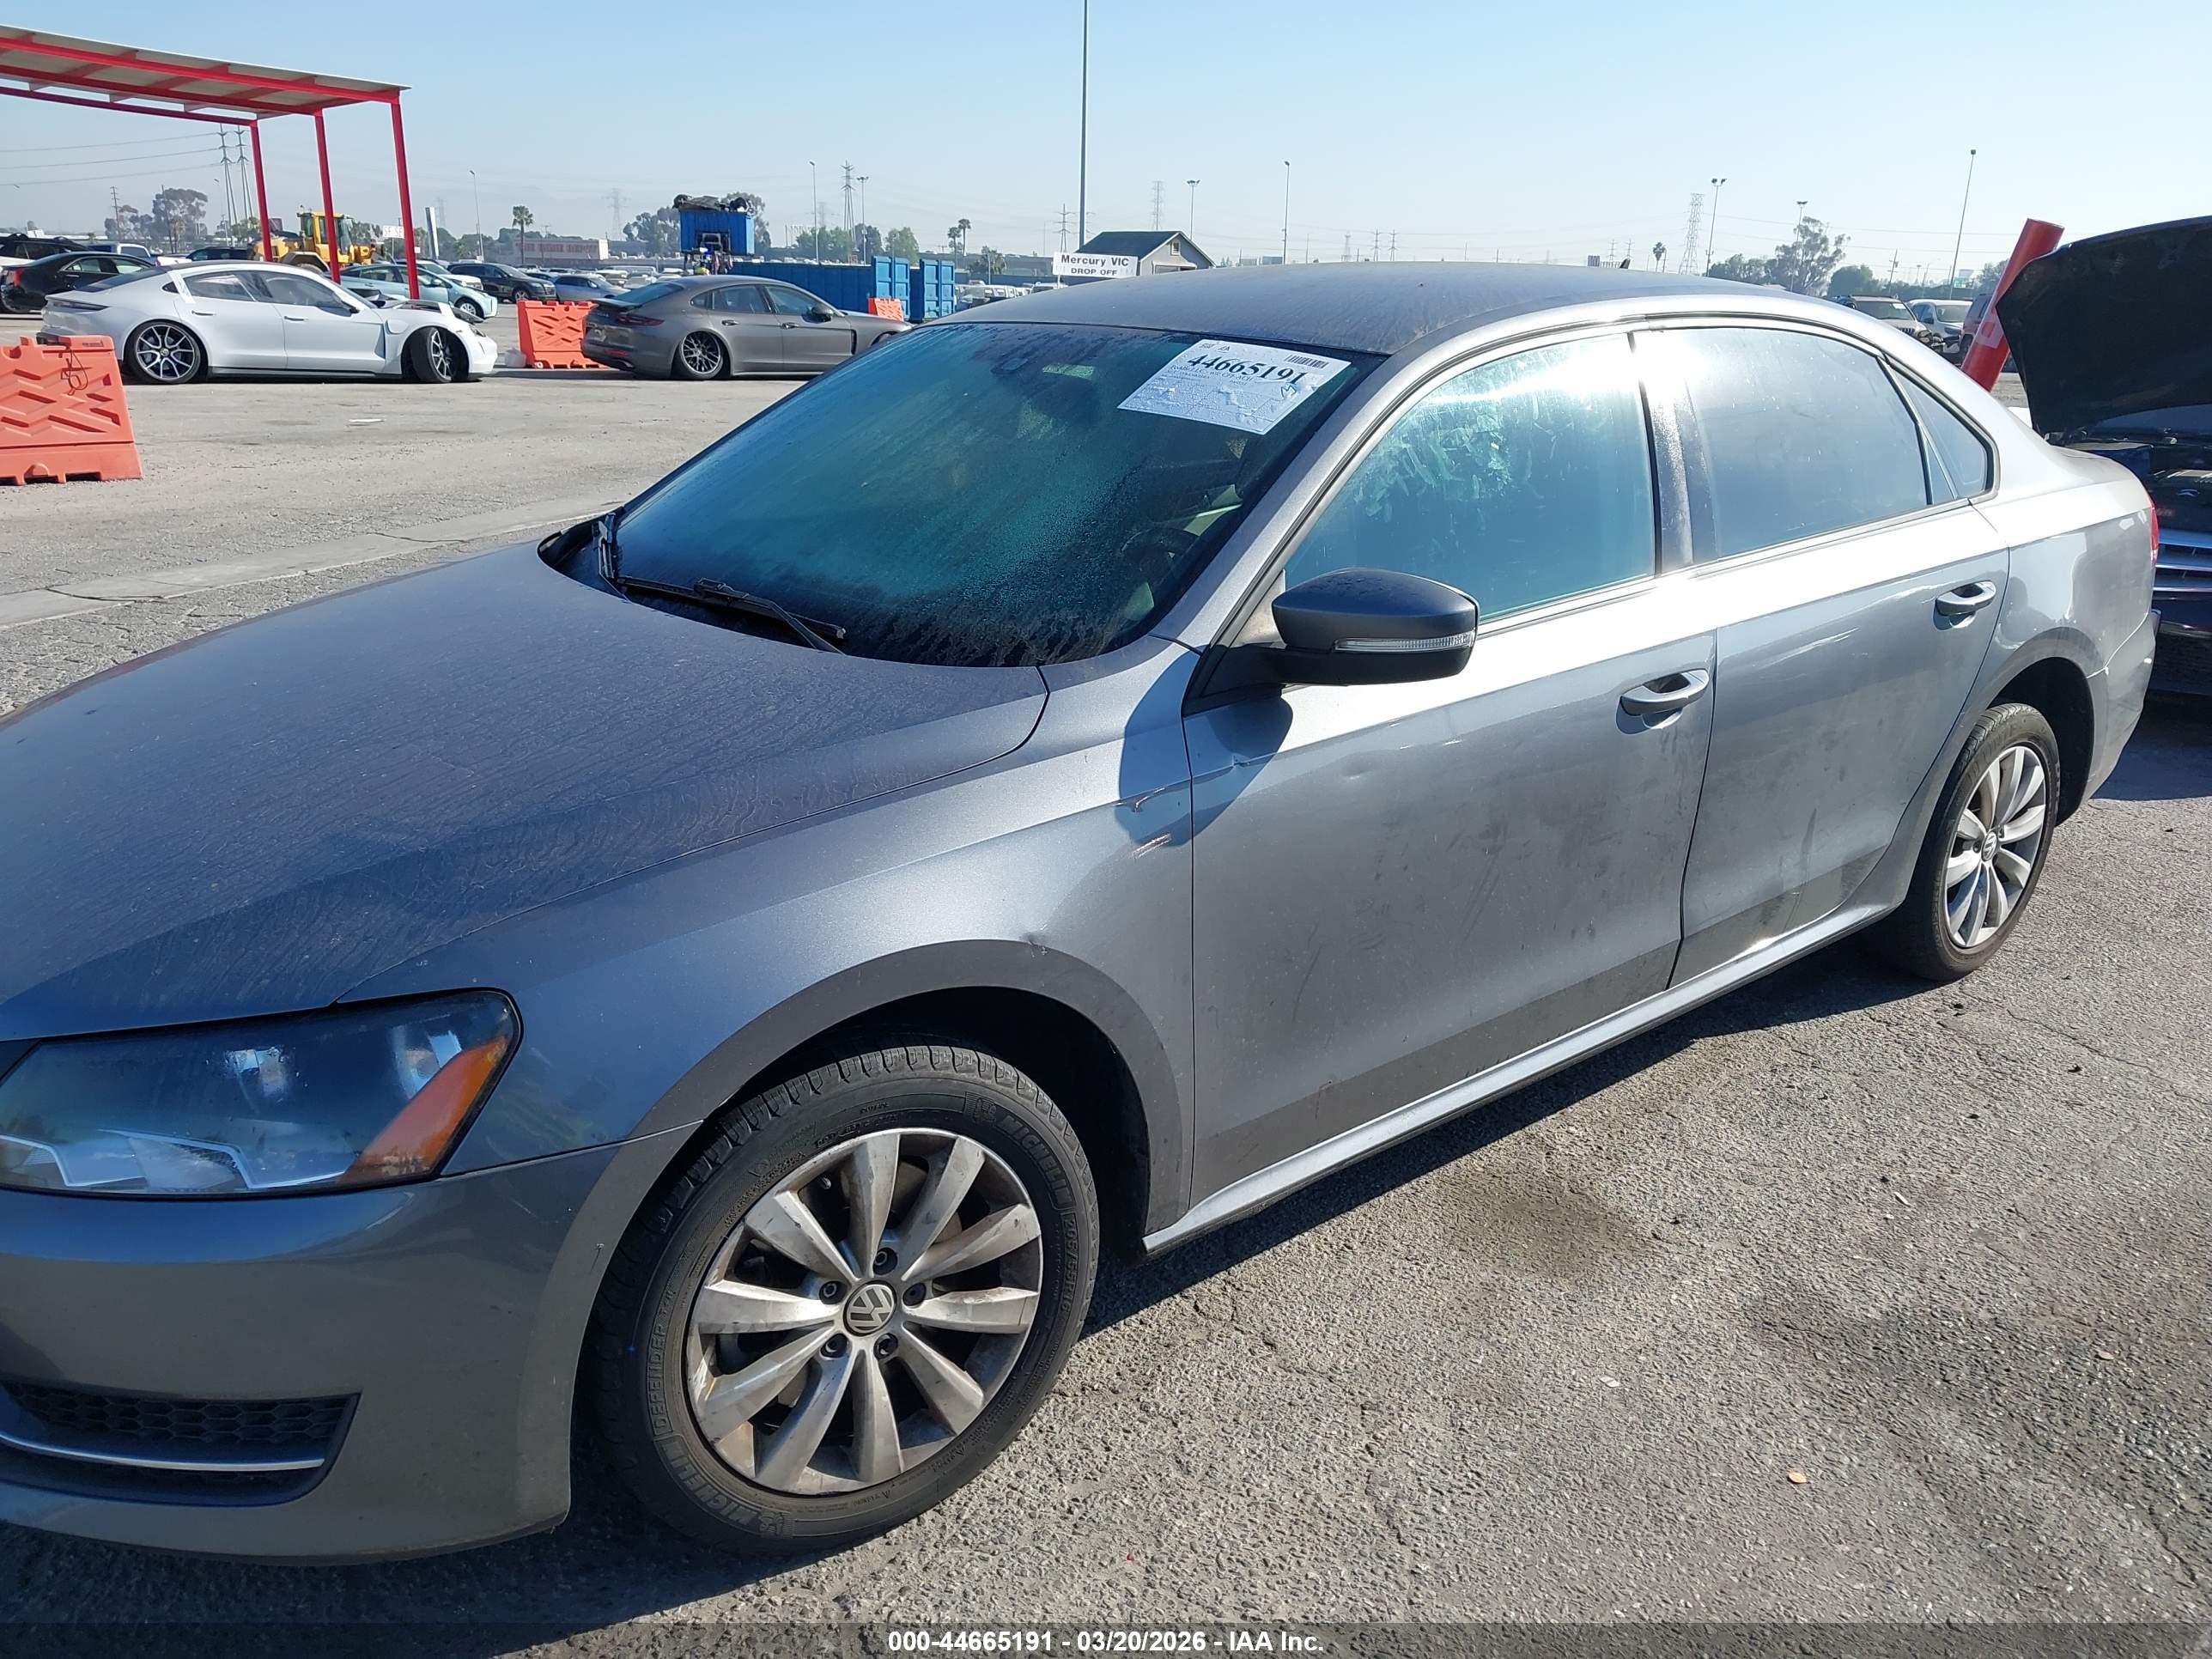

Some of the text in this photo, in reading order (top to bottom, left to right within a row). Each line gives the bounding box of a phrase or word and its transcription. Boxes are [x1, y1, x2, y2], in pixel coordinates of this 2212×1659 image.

[1060, 254, 1129, 267] Mercury VIC
[1188, 353, 1310, 385] 44665191
[995, 1115, 1078, 1313] MICHELIN 205/55R16
[649, 1324, 668, 1429] DEFENDER
[661, 1440, 758, 1526] MICHELIN
